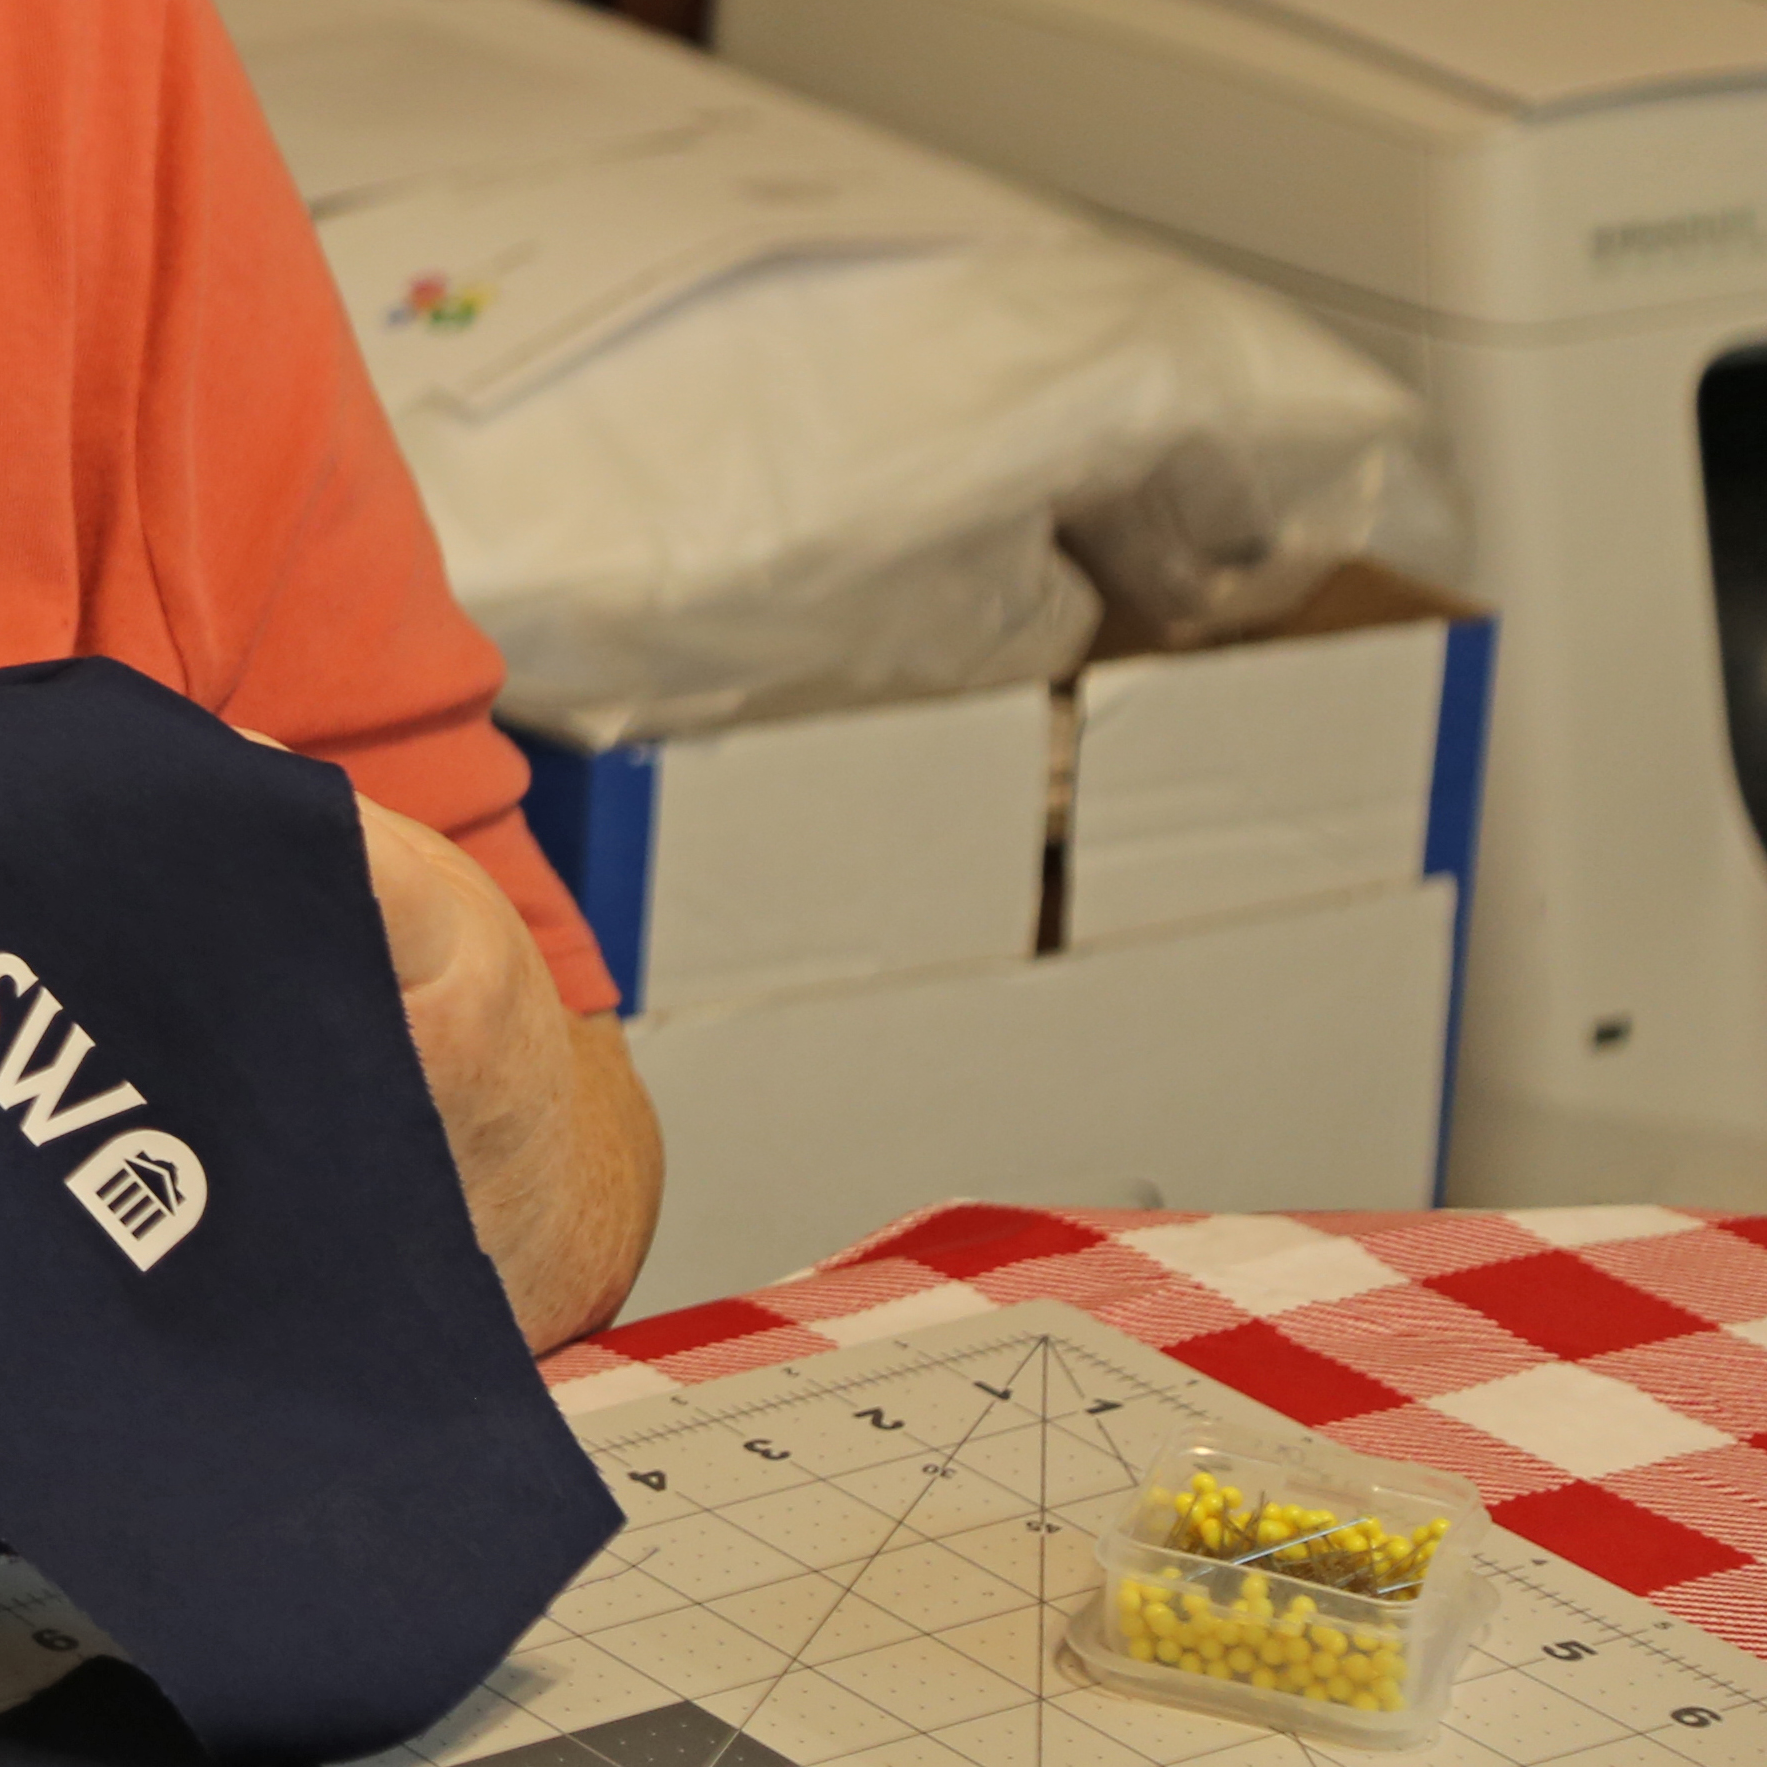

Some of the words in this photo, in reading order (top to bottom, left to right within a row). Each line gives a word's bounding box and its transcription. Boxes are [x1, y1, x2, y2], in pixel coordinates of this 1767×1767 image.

[1085, 1398, 1123, 1415] 1
[853, 1406, 905, 1431] 2
[743, 1438, 791, 1461] 3
[627, 1469, 667, 1493] 4
[1541, 1639, 1600, 1662] 5
[1669, 1705, 1724, 1729] 6
